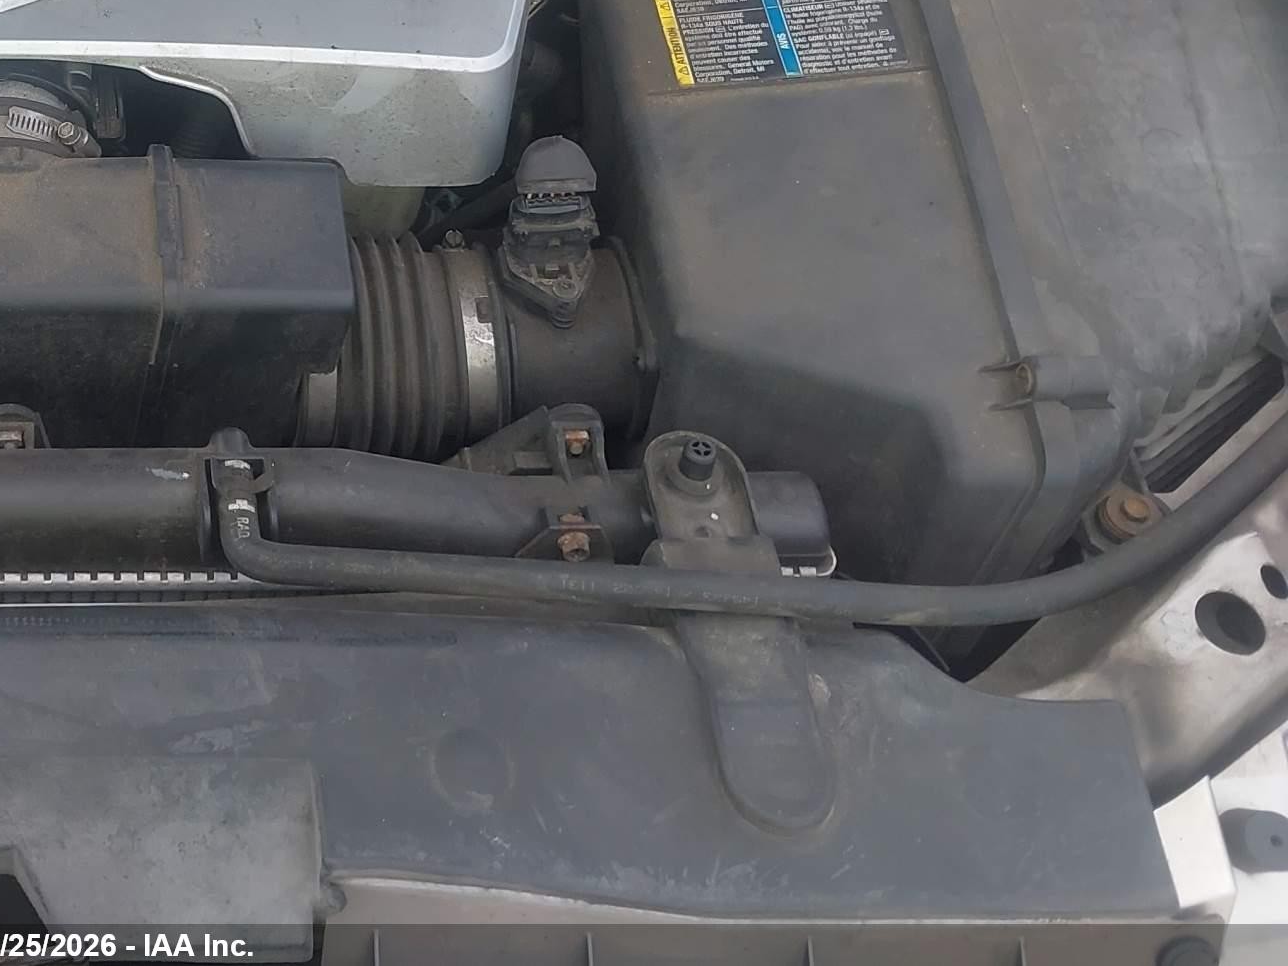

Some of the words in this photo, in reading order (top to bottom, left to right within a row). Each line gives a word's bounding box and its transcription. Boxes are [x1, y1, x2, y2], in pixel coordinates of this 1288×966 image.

[668, 27, 687, 66] ATTENTION
[776, 32, 791, 50] AVIS
[236, 517, 250, 539] RAD
